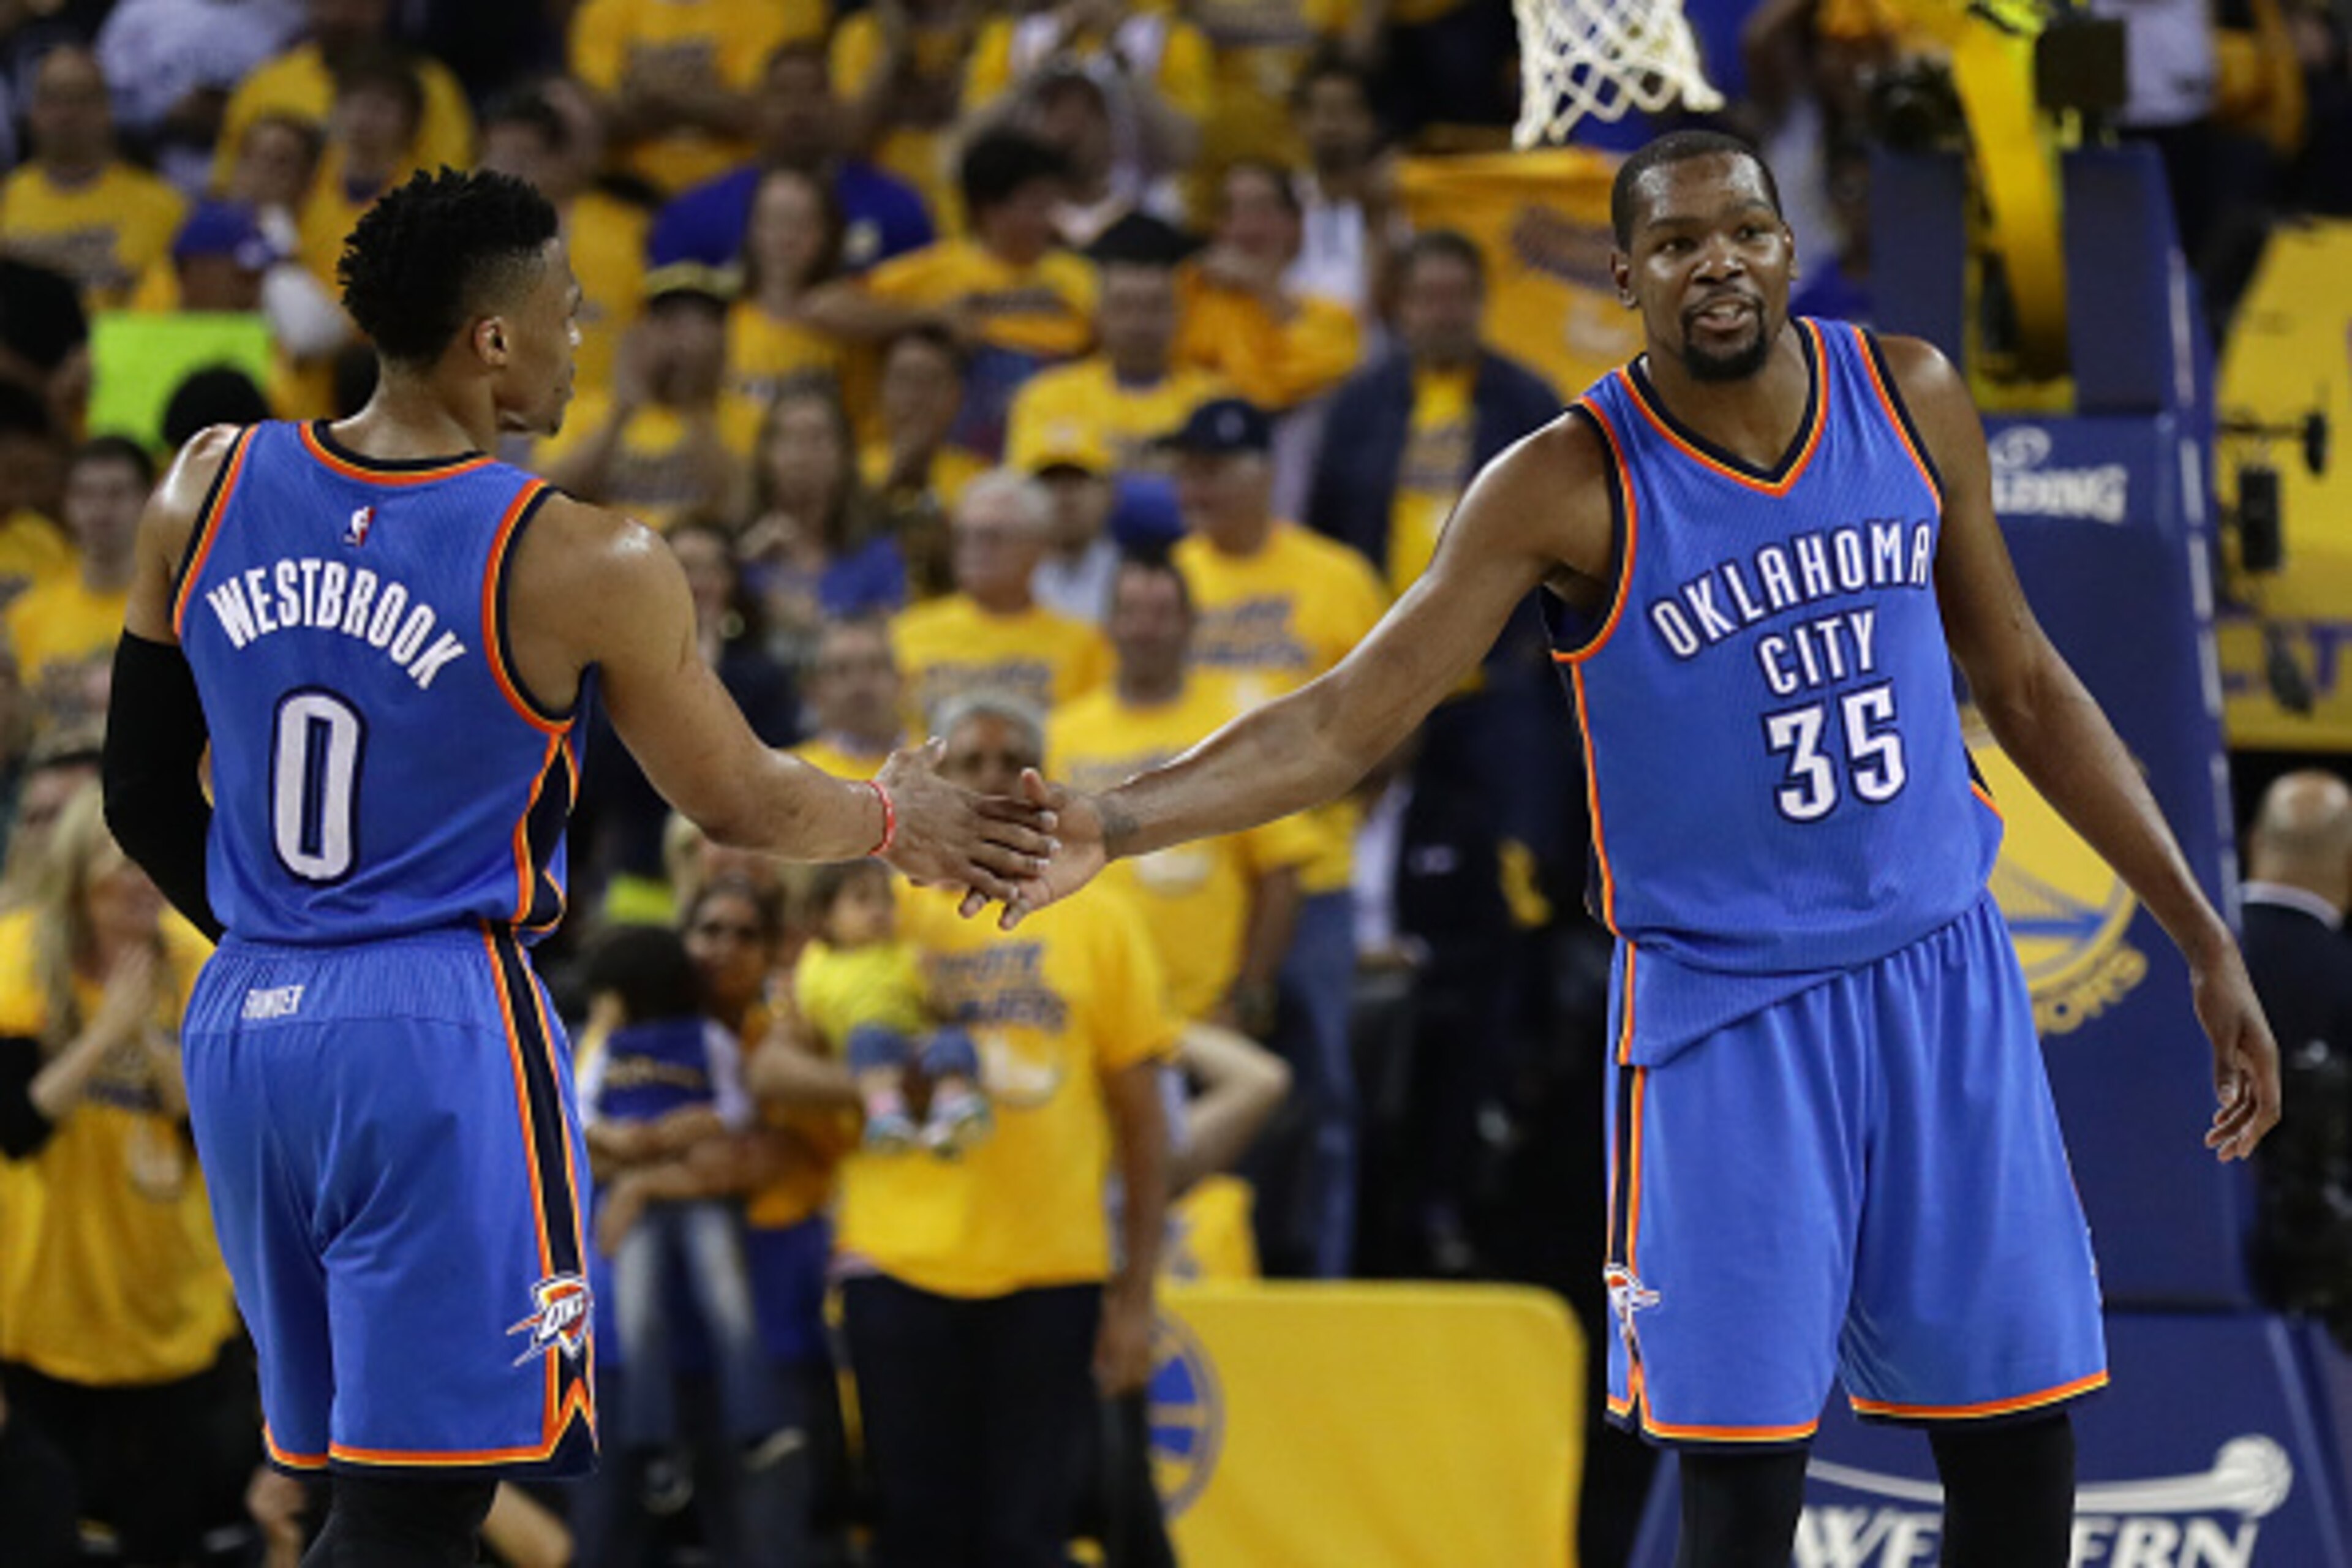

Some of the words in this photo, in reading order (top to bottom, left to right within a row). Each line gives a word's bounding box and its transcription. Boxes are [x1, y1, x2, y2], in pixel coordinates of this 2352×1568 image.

[206, 557, 467, 690] WESTBROOK
[1649, 519, 1931, 658] OKLAHOMA
[1757, 604, 1875, 696] CITY
[271, 687, 366, 885] 0
[1764, 681, 1907, 820] 35
[1792, 1504, 2258, 1568] WEERN
